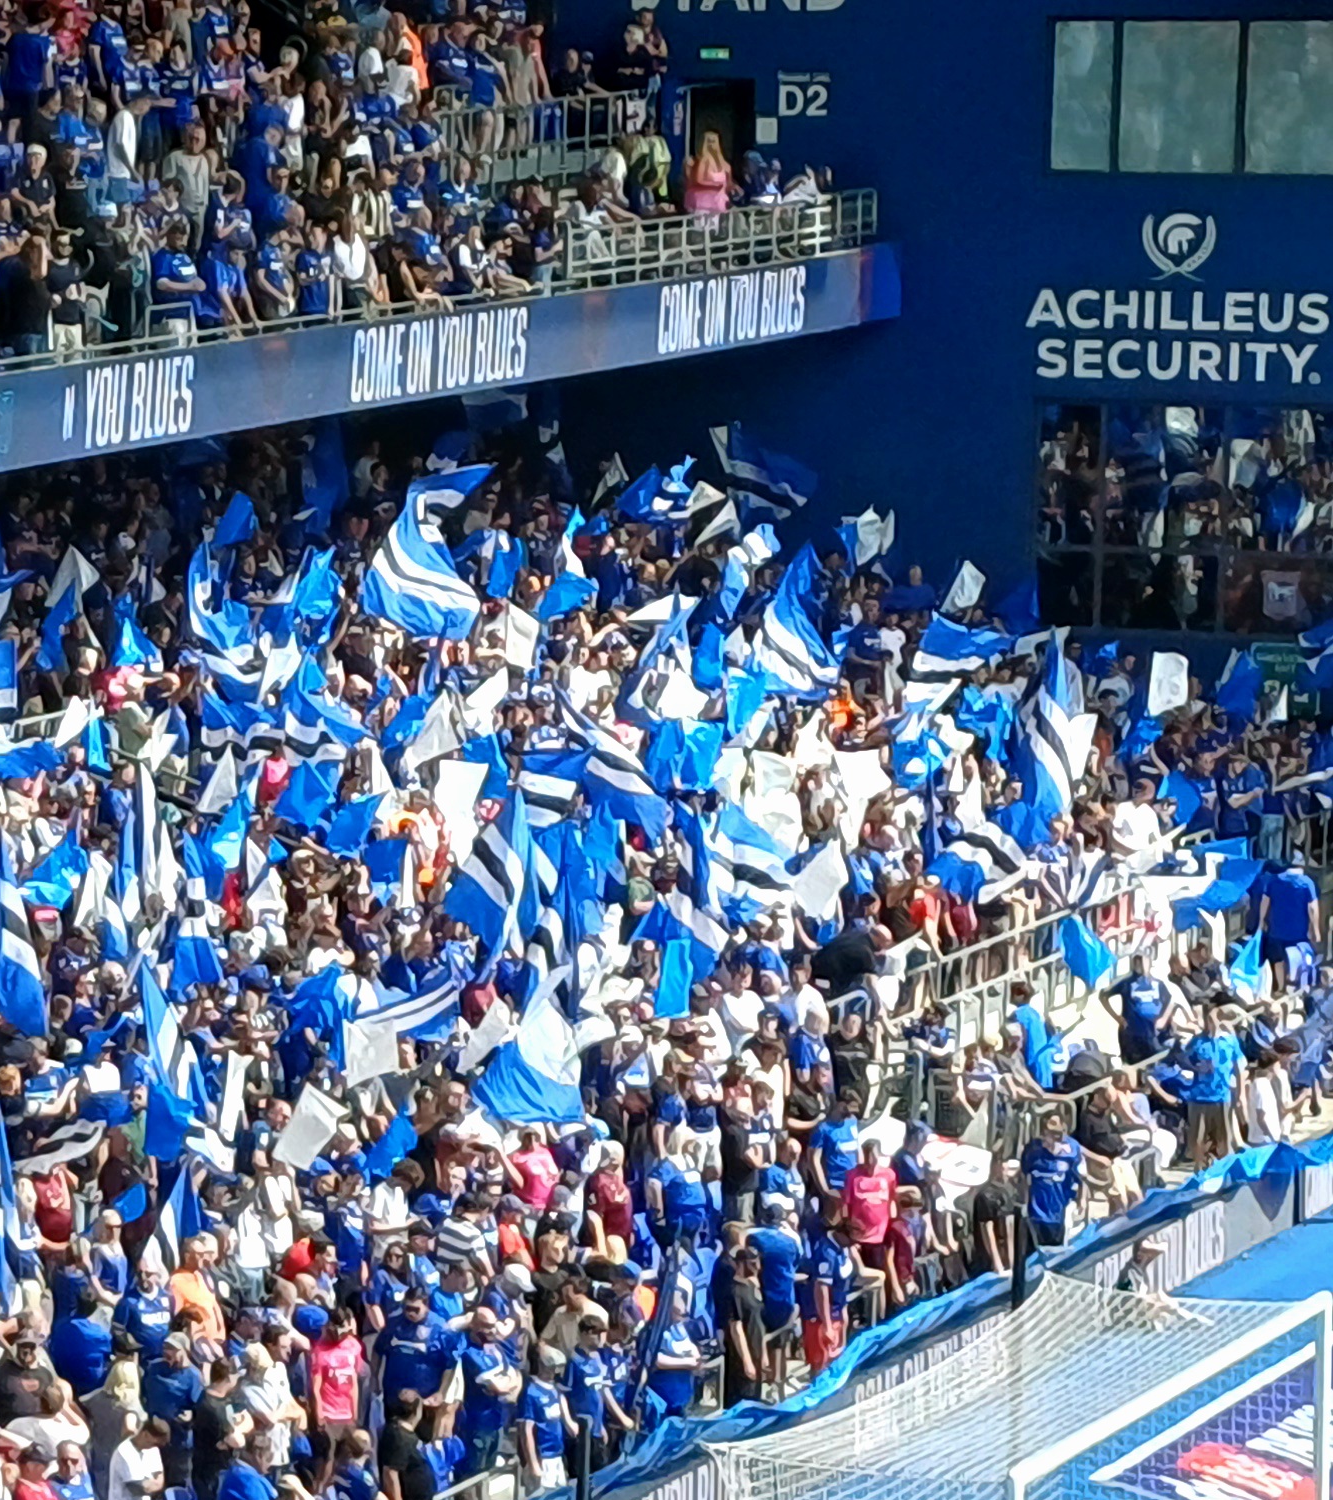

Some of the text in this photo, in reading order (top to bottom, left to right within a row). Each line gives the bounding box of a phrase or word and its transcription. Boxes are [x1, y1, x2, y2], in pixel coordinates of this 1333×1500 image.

[778, 85, 828, 116] D2
[658, 265, 806, 354] COME ON YOU BLUES
[1025, 288, 1330, 334] ACHILLEUS
[351, 307, 528, 402] COME ON YOU BLUES
[85, 363, 129, 448] YOU
[130, 355, 194, 441] BLUES
